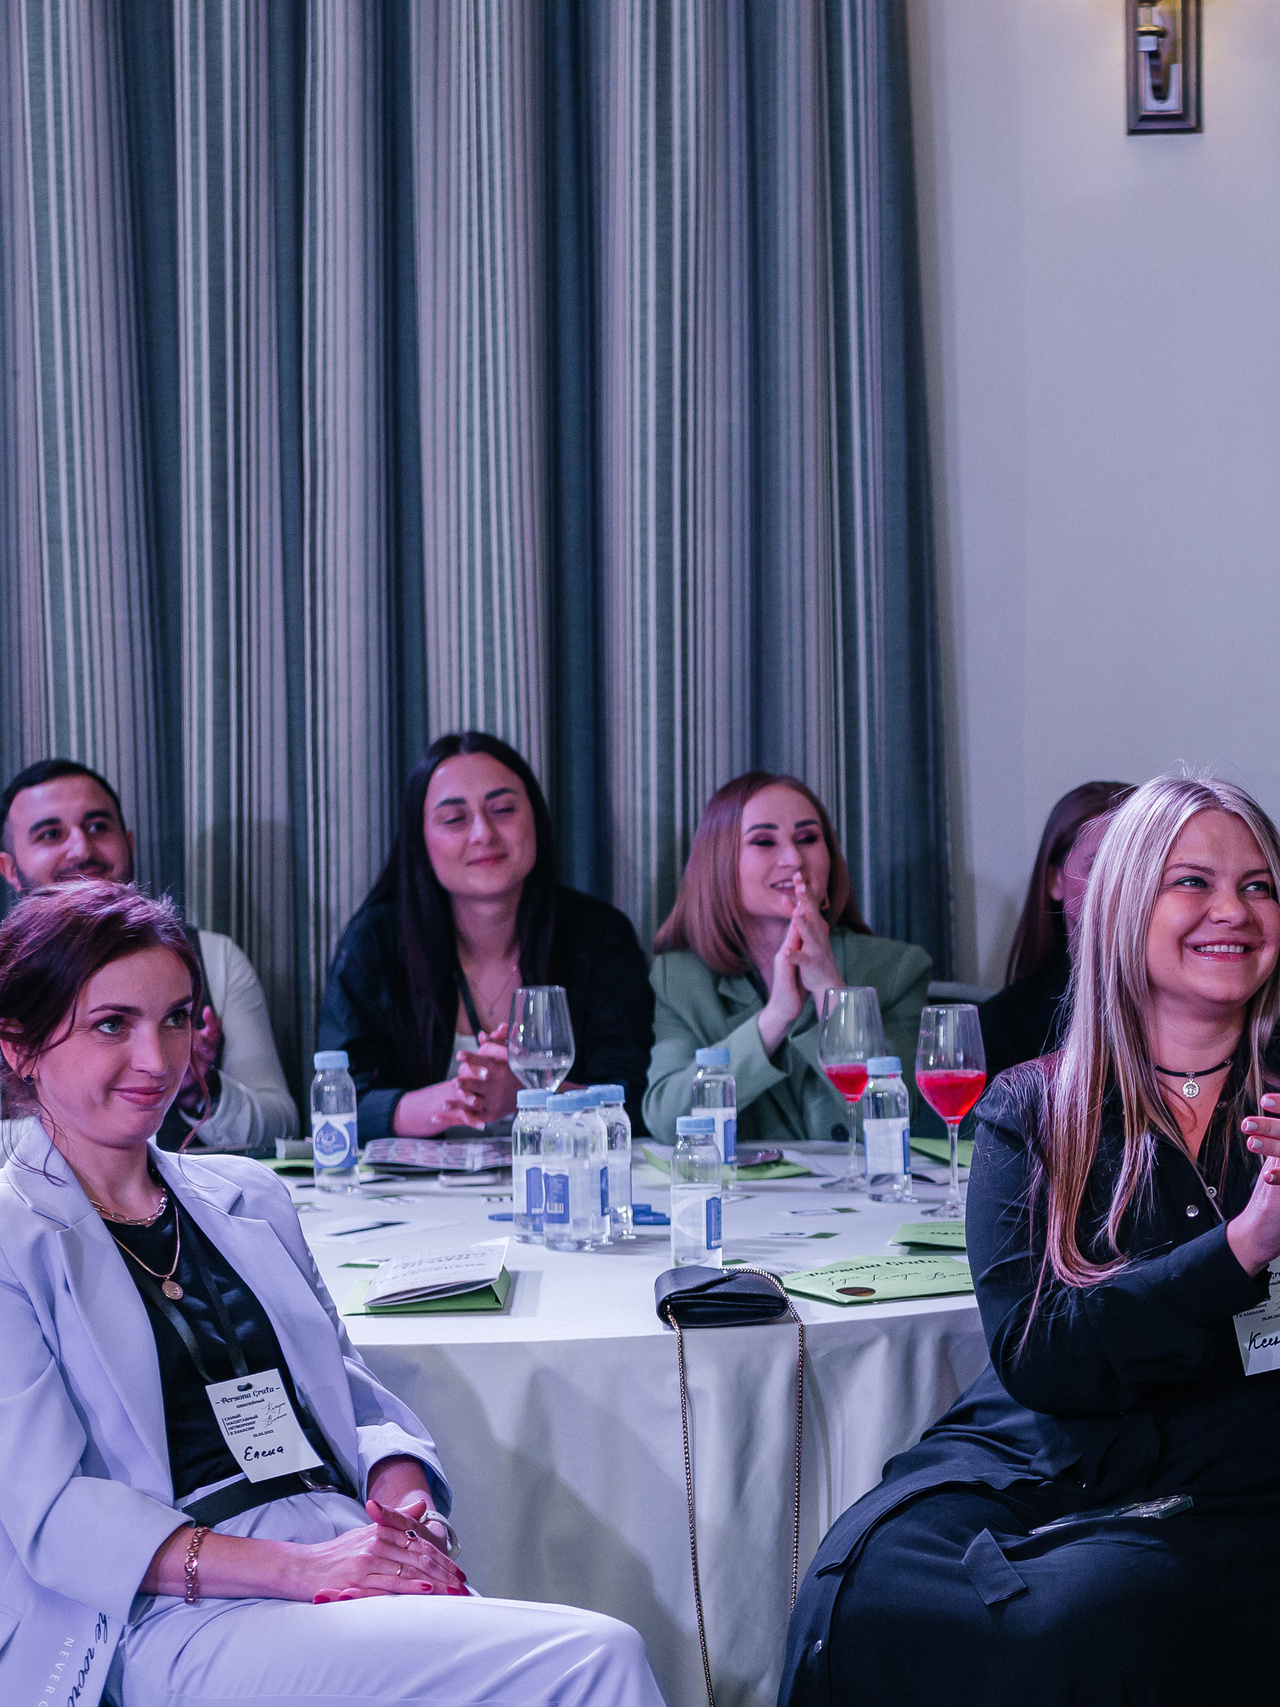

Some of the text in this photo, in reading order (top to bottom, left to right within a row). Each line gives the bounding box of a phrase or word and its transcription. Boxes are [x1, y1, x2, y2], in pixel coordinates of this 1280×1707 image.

[221, 1386, 274, 1404] Persona Grata
[244, 1446, 284, 1461] Елена
[44, 1637, 76, 1695] NEVER
